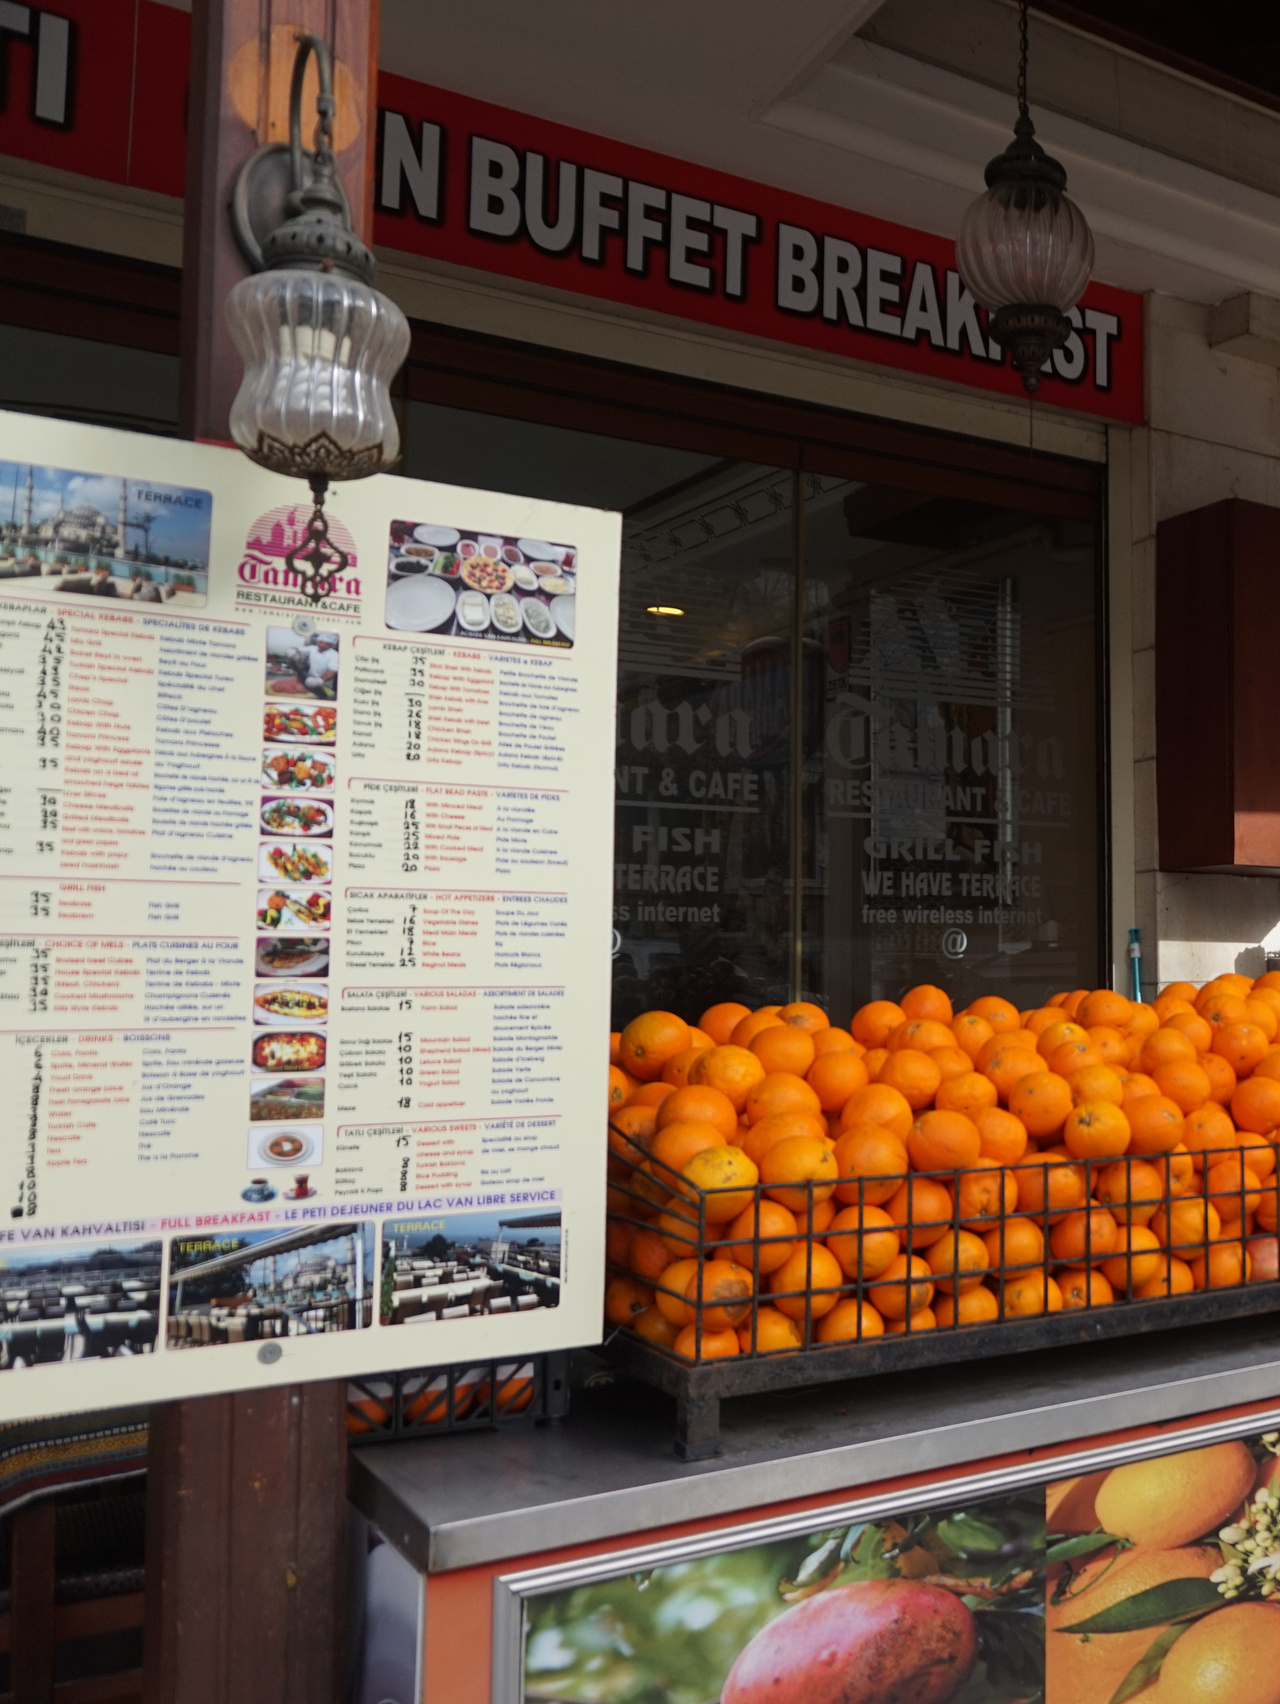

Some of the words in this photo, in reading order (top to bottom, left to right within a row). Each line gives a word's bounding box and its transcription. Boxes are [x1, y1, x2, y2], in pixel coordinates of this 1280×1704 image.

[469, 136, 758, 299] BUFFET
[777, 222, 1119, 388] BREAKST
[136, 489, 203, 508] TERRACE
[57, 608, 95, 619] SPECIAL
[658, 767, 679, 797] &
[689, 769, 759, 801] CAFE
[1018, 791, 1071, 817] CAFE
[632, 825, 720, 856] FISH
[863, 836, 961, 862] GRILL
[974, 838, 1042, 866] FISH
[59, 883, 84, 892] GRILL
[87, 884, 106, 892] FISH
[861, 871, 894, 896] WE
[901, 871, 952, 898] HAVE
[959, 872, 1041, 900] TERRACE
[637, 901, 720, 923] internet
[861, 904, 897, 925] free
[903, 905, 973, 925] wireless
[978, 906, 1043, 925] internet
[45, 940, 83, 948] CHOICE
[86, 940, 99, 948] OF
[942, 927, 968, 960] @
[398, 1000, 413, 1010] 15
[123, 1033, 171, 1041] BOISSONS
[398, 1032, 413, 1043] 15
[398, 1044, 412, 1053] 10
[398, 1056, 413, 1065] 10
[399, 1067, 413, 1076] 10
[399, 1078, 413, 1086] 10
[412, 1125, 447, 1134] VARIOUS
[395, 1135, 411, 1148] 15
[21, 1227, 55, 1239] VAN
[61, 1221, 144, 1236] KAHVALTISI
[161, 1218, 192, 1231] FULL
[195, 1210, 272, 1229] BREAKFAST
[284, 1209, 297, 1220] LE
[301, 1205, 327, 1219] PETI
[330, 1200, 394, 1217] DEJEUNER
[397, 1199, 415, 1212] DU
[417, 1197, 444, 1210] LAC
[446, 1195, 474, 1208] VAN
[477, 1193, 507, 1206] LIBRE
[510, 1190, 556, 1204] SERVICE
[392, 1219, 446, 1233] TERRACE
[179, 1238, 240, 1254] TERRACE
